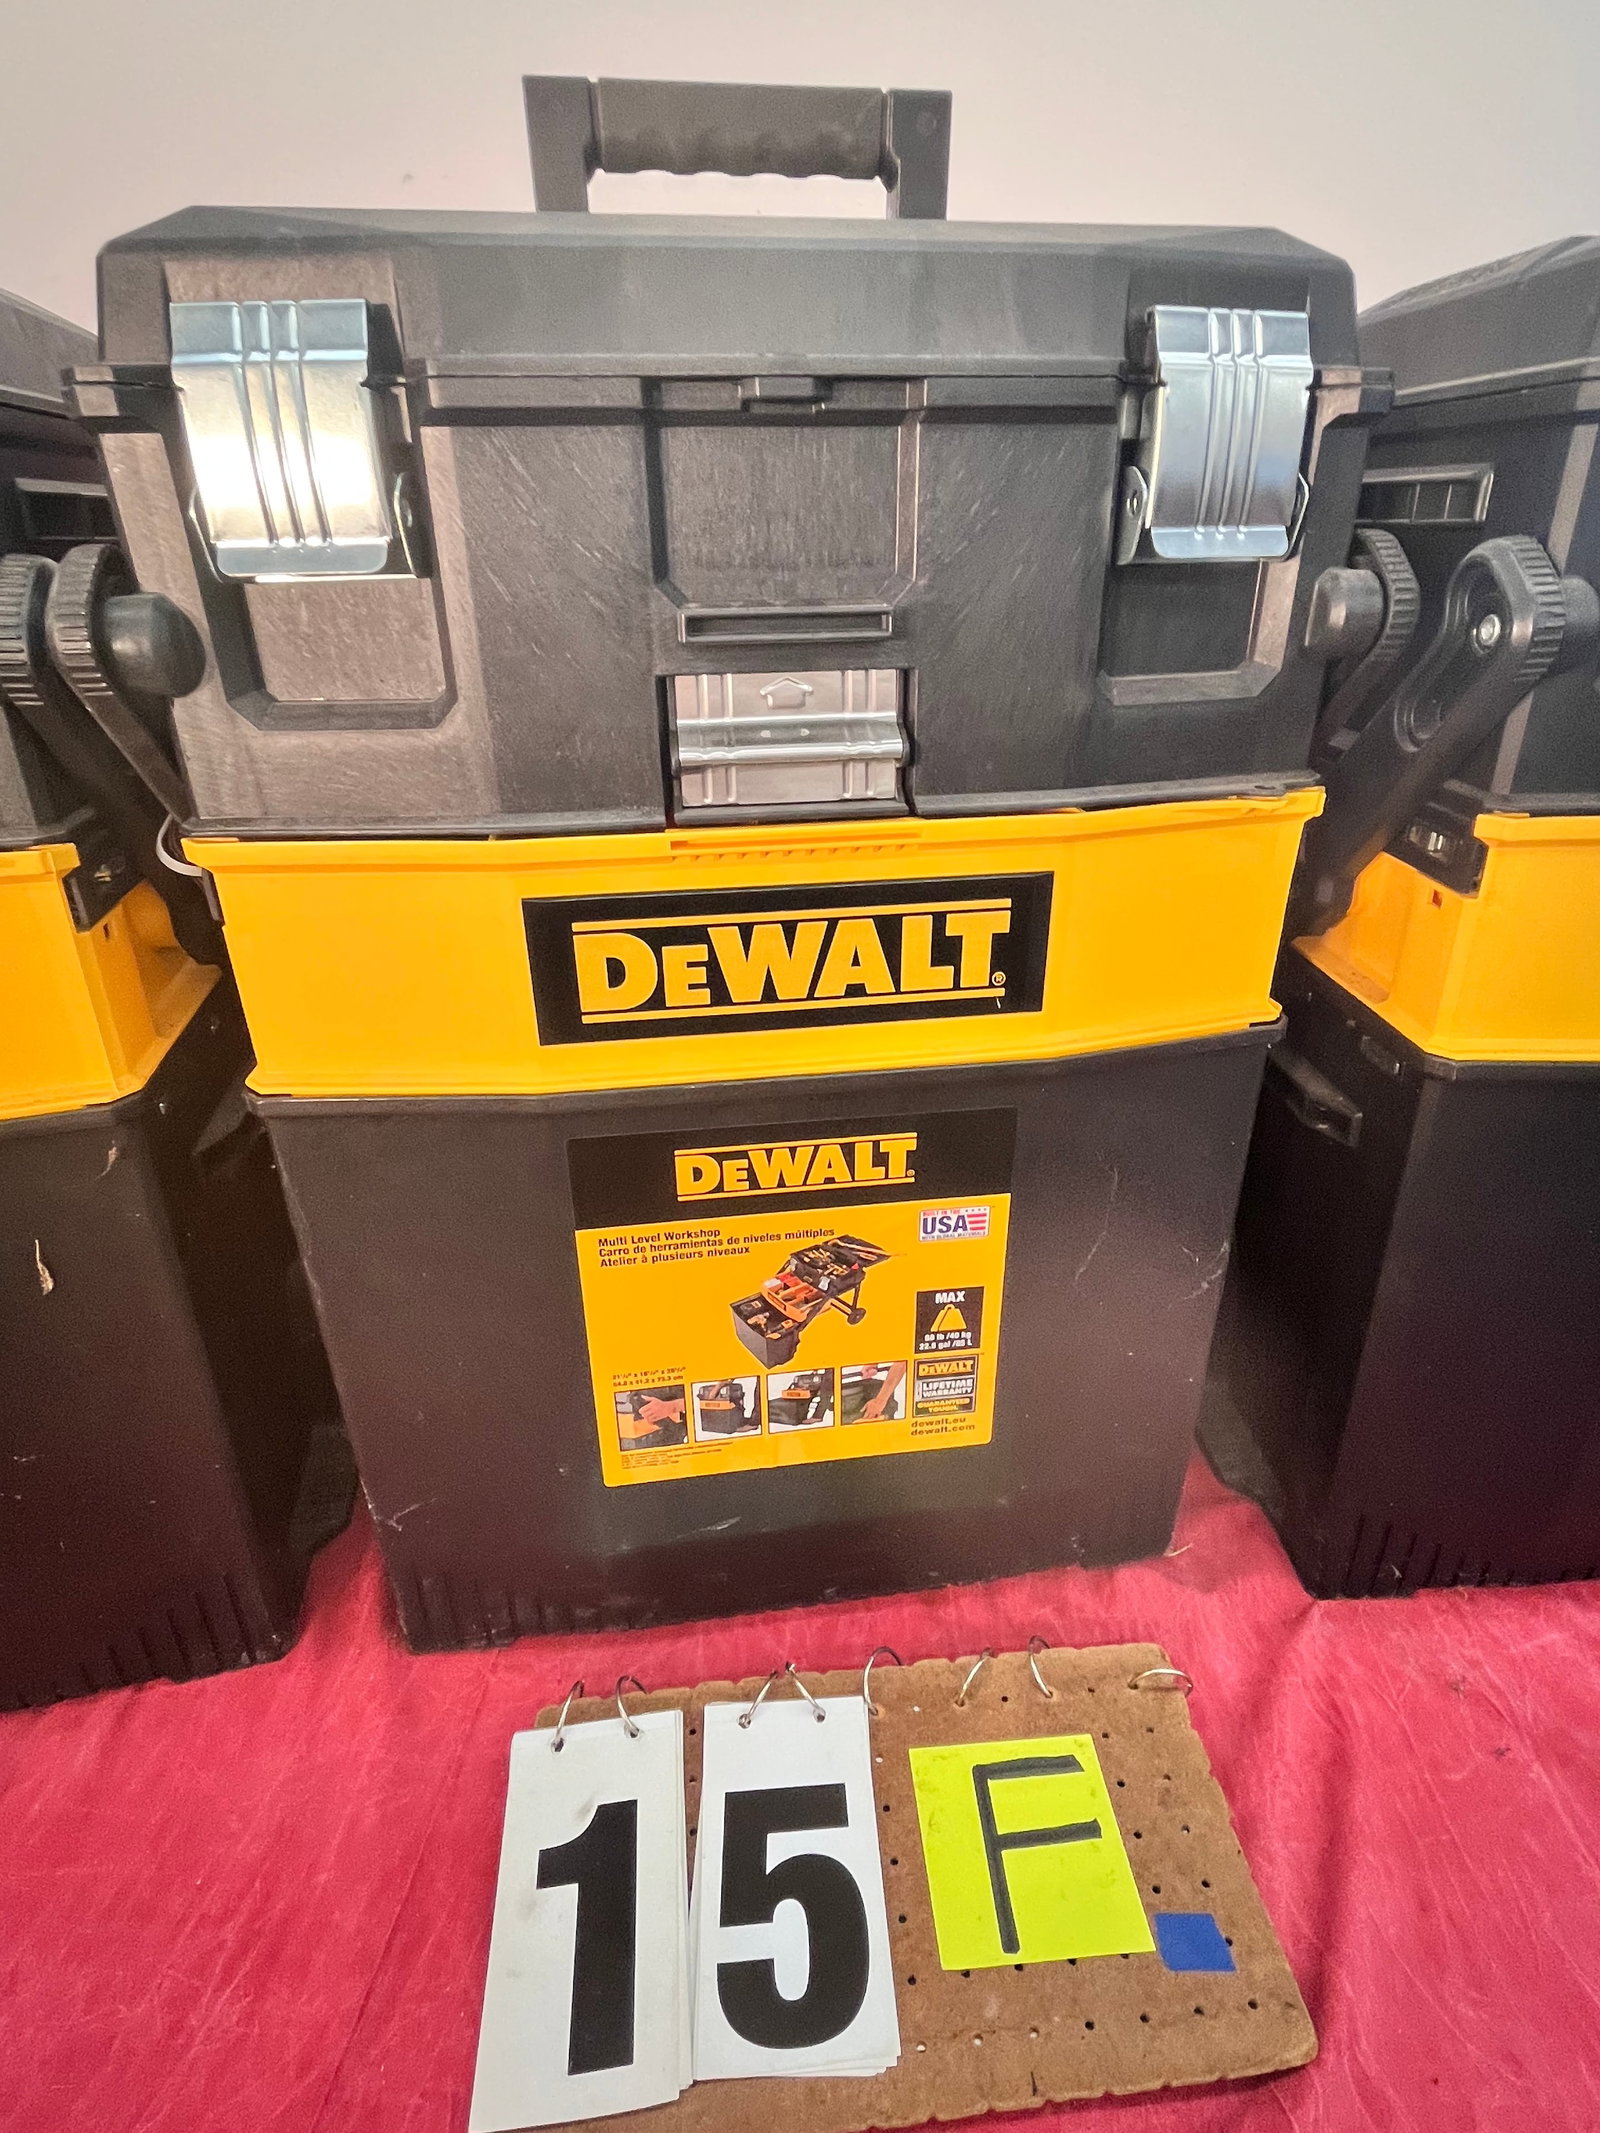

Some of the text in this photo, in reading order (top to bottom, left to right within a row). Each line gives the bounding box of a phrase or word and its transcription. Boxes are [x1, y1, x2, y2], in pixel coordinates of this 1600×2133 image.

[922, 1214, 968, 1235] USA
[598, 1228, 721, 1247] Multi Level Workshop
[598, 1227, 836, 1257] Carro de herramientas de niveles múltiples
[599, 1245, 751, 1267] Atelier à plusieurs niveaux
[935, 1290, 966, 1304] MAX
[967, 1338, 973, 1346] L
[922, 1379, 974, 1391] LIFETIME
[922, 1387, 973, 1398] WARRANTY
[911, 1417, 966, 1428] dewalt.eu
[910, 1424, 975, 1436] dewalt.com
[972, 1754, 1102, 1956] F
